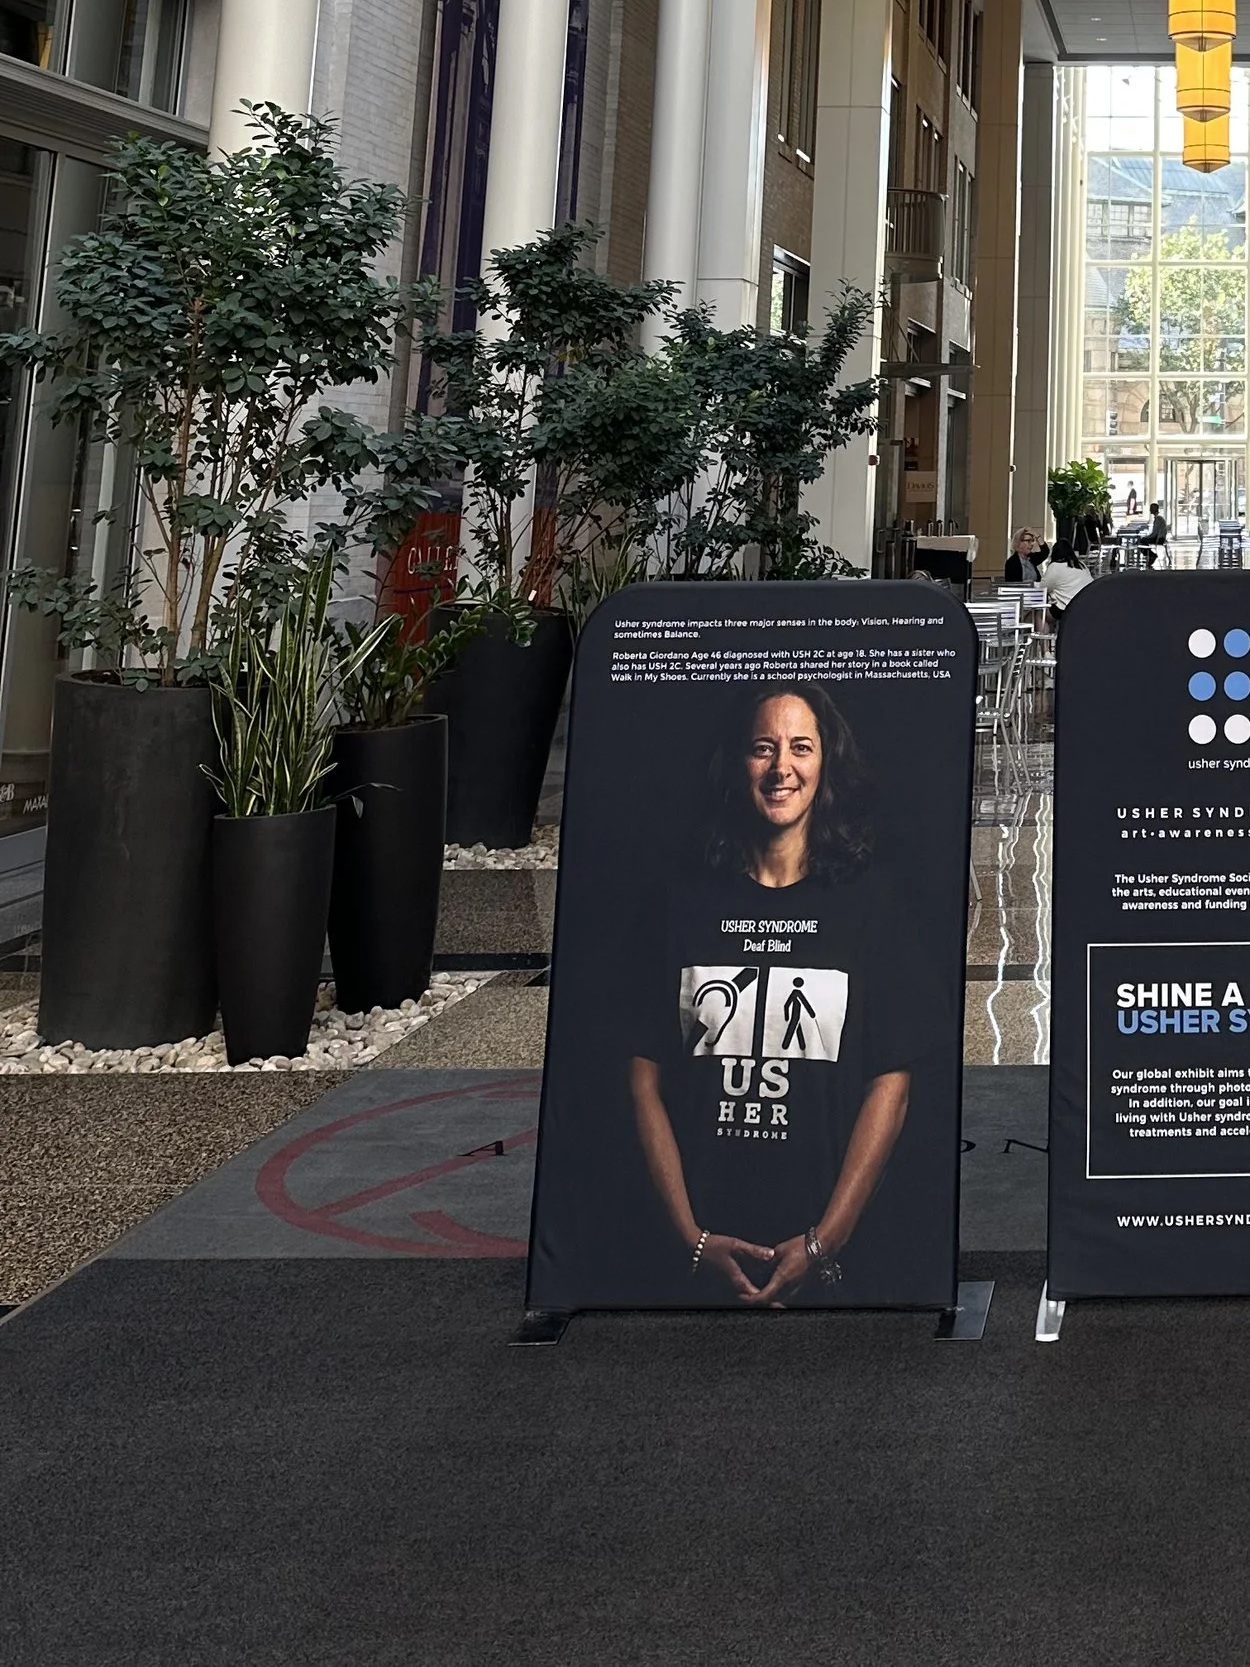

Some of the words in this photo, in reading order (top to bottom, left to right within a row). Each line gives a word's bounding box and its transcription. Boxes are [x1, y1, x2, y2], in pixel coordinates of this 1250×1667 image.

[614, 619, 639, 628] Usher
[641, 619, 685, 629] syndrome
[686, 618, 722, 628] impacts
[724, 618, 747, 627] three
[749, 618, 775, 628] major
[807, 617, 816, 626] in
[817, 617, 833, 626] the
[891, 615, 925, 626] Hearing
[926, 616, 943, 624] and
[613, 629, 662, 638] sometimes
[612, 651, 647, 659] Roberta
[648, 651, 689, 659] Giordano
[690, 651, 709, 661] Age
[710, 650, 721, 659] 46
[722, 649, 768, 660] diagnosed
[770, 649, 790, 658] with
[791, 649, 811, 658] USH
[812, 649, 824, 658] 2C
[825, 649, 835, 657] at
[836, 650, 853, 659] age
[868, 648, 885, 657] She
[886, 648, 902, 657] has
[911, 648, 934, 656] sister
[936, 648, 955, 657] who
[610, 672, 632, 681] Walk
[633, 672, 642, 681] in
[644, 672, 658, 682] My
[690, 671, 731, 682] Currently
[732, 671, 749, 680] she
[750, 671, 757, 680] is
[766, 671, 796, 680] school
[797, 670, 852, 681] psychologist
[854, 670, 862, 678] in
[932, 669, 950, 678] USA
[1188, 757, 1220, 769] usher
[1116, 807, 1182, 818] USHER
[1114, 873, 1135, 883] The
[1137, 873, 1169, 883] Usher
[1171, 872, 1226, 885] Syndrome
[1111, 886, 1130, 897] the
[1132, 887, 1156, 897] arts,
[1158, 885, 1222, 896] educational
[1121, 901, 1178, 910] awareness
[1180, 899, 1201, 909] and
[1204, 898, 1247, 910] funding
[720, 920, 756, 933] USHER
[758, 920, 818, 934] SYNDROME
[743, 939, 766, 952] Deaf
[767, 939, 792, 952] Blind
[1116, 982, 1212, 1008] SHINE
[1220, 981, 1244, 1006] A
[1117, 1008, 1220, 1034] USHER
[1111, 1068, 1133, 1079] Our
[1135, 1067, 1171, 1081] global
[1174, 1067, 1214, 1078] exhibit
[1216, 1067, 1244, 1078] aims
[1110, 1082, 1167, 1095] syndrome
[1169, 1081, 1215, 1094] through
[1128, 1097, 1139, 1108] In
[1142, 1096, 1193, 1108] addition,
[1195, 1098, 1216, 1107] our
[1218, 1095, 1242, 1109] goal
[718, 1101, 788, 1125] HER
[1115, 1111, 1146, 1124] living
[1149, 1111, 1175, 1122] with
[1178, 1111, 1212, 1122] Usher
[717, 1128, 788, 1140] SYNDROME
[1128, 1126, 1192, 1137] treatments
[1194, 1125, 1216, 1136] and
